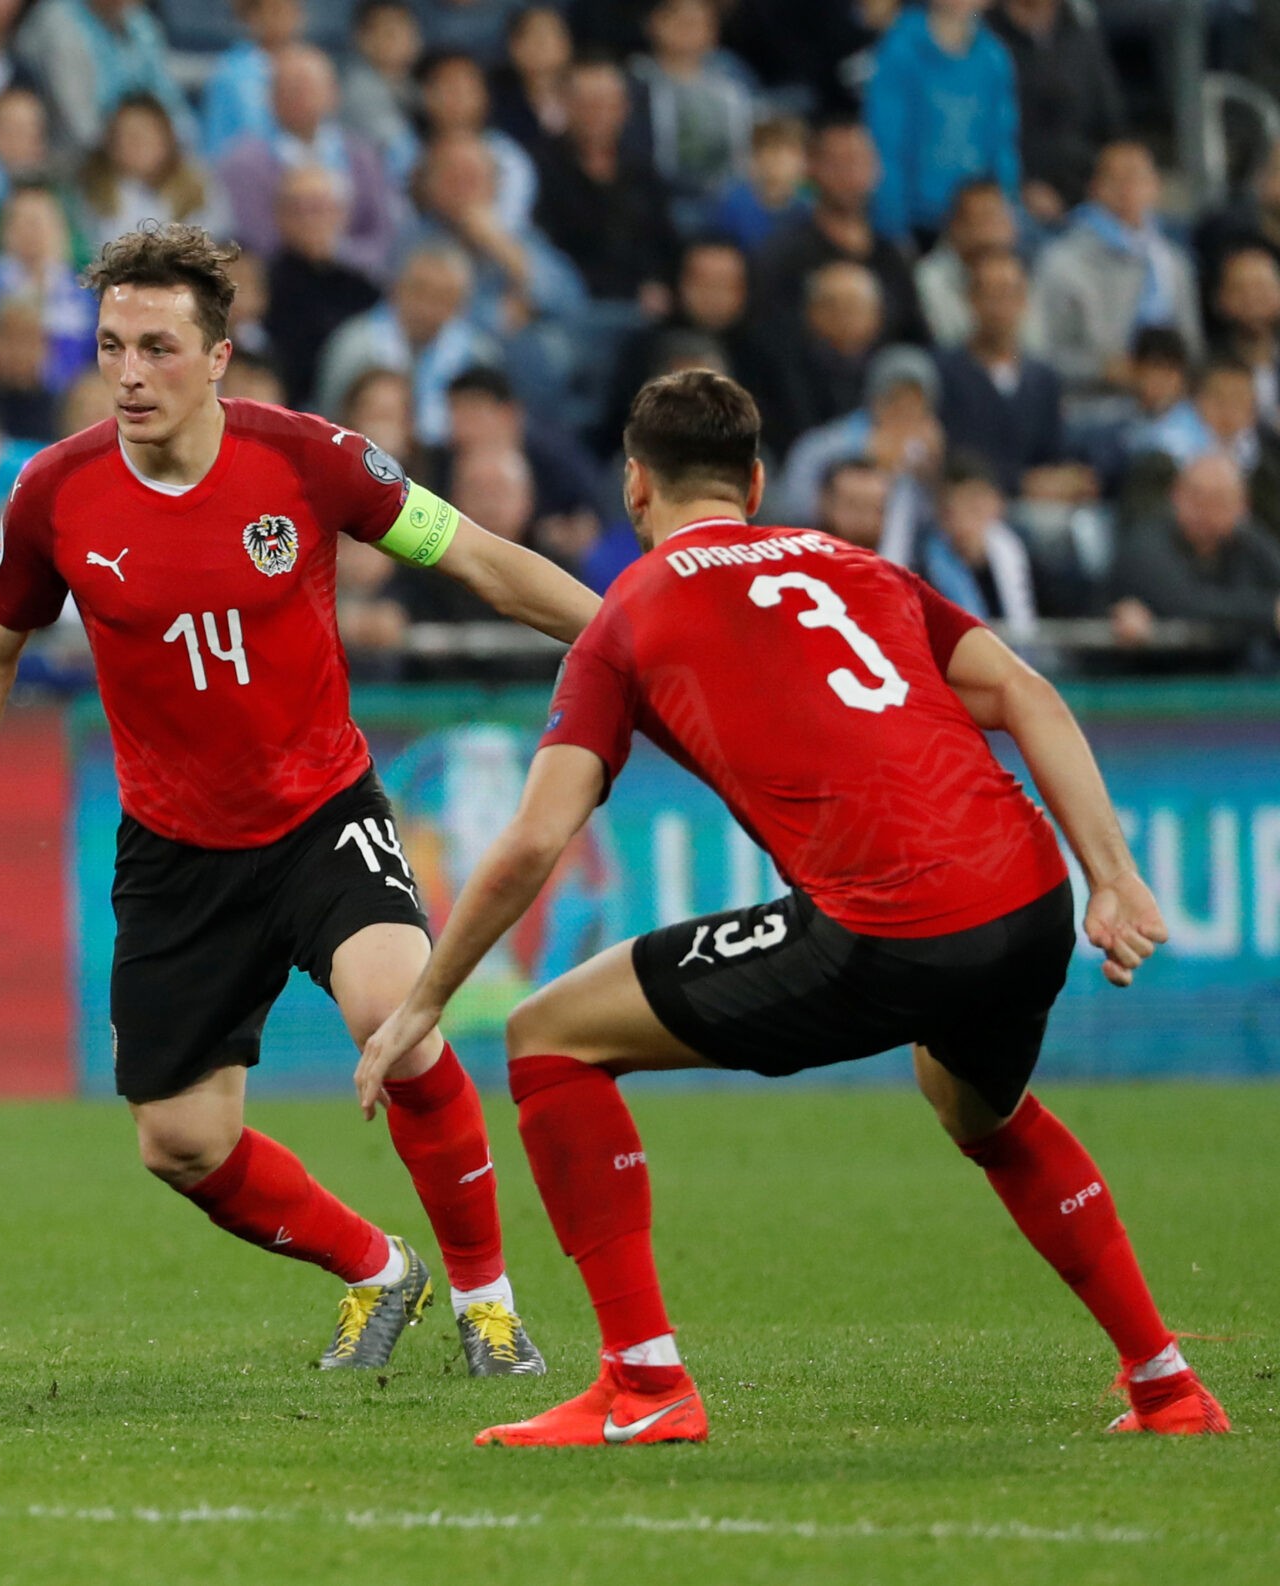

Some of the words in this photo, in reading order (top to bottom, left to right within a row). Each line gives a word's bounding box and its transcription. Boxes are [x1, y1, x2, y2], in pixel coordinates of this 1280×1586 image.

[414, 548, 429, 561] NO
[426, 532, 439, 547] TO
[435, 502, 450, 532] RACIS
[163, 608, 250, 692] 14
[748, 571, 910, 714] 3
[334, 817, 410, 879] 14
[713, 914, 788, 958] 3
